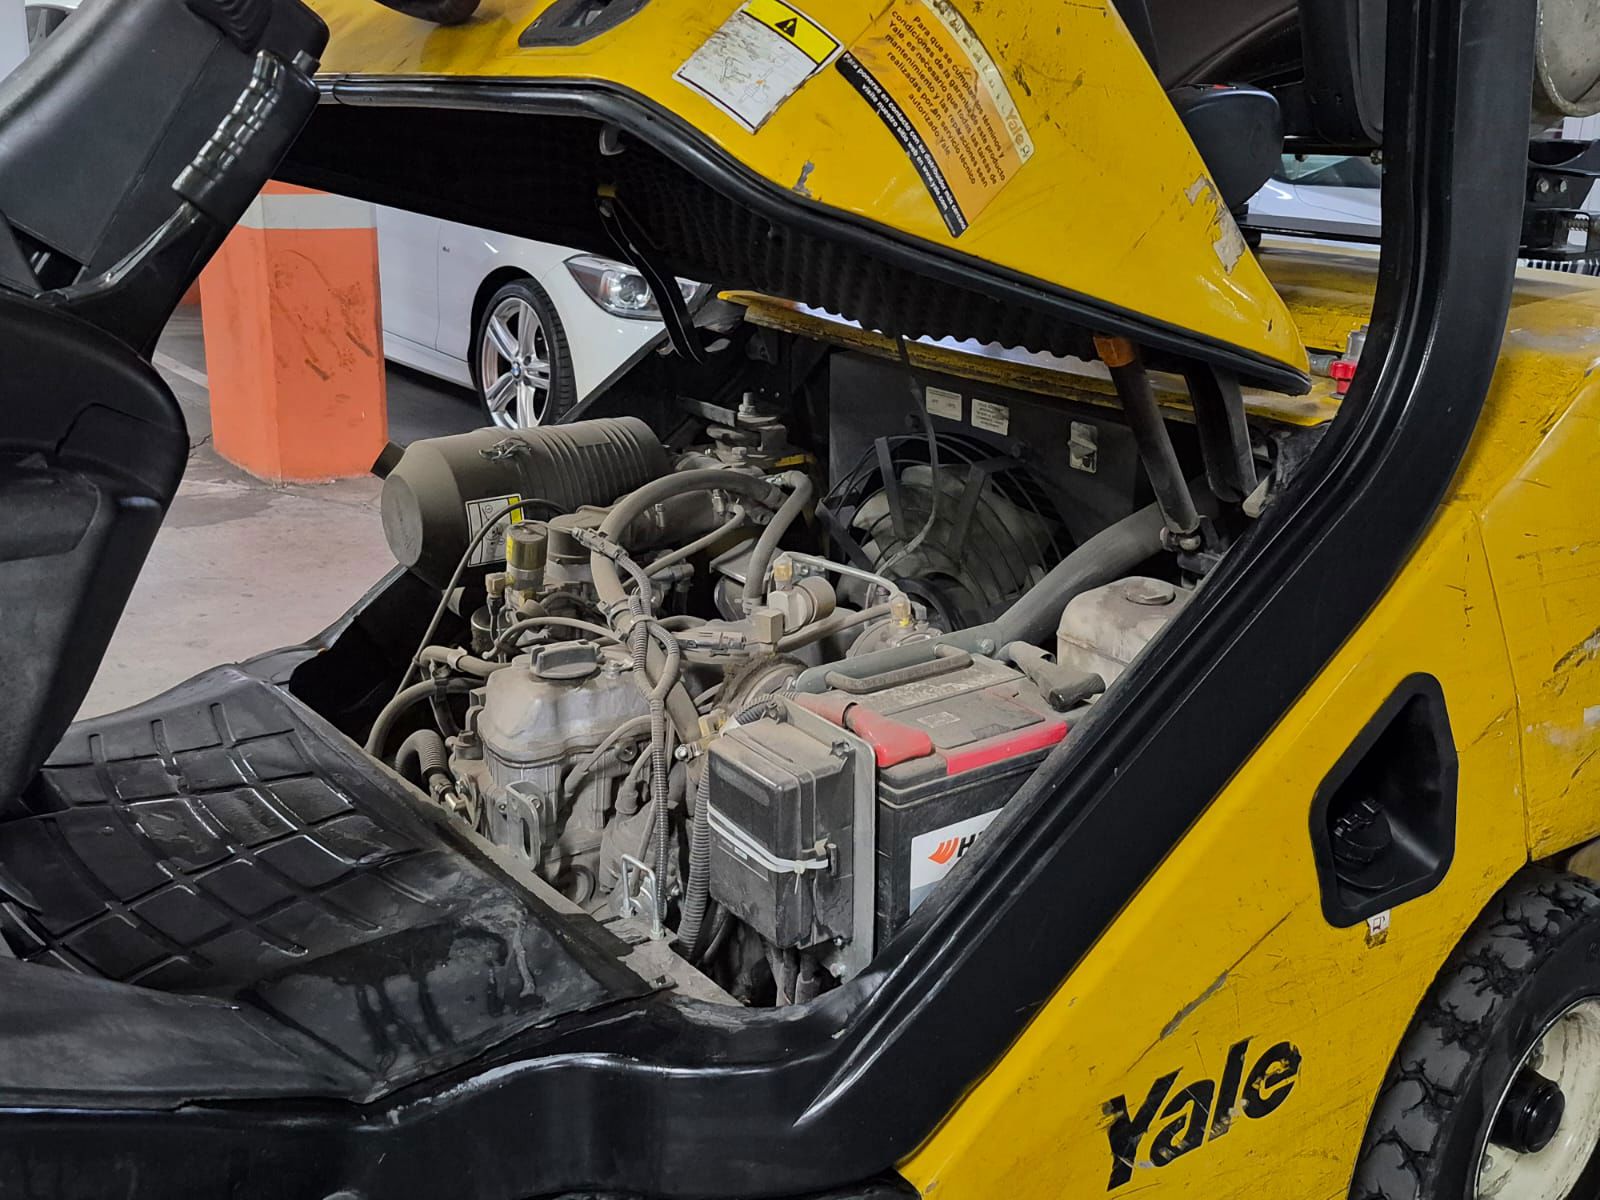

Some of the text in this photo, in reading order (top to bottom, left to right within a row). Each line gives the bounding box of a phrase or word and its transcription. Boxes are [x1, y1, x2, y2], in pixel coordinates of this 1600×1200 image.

[843, 53, 858, 69] Para
[856, 69, 881, 93] ponerse
[881, 93, 889, 103] en
[888, 102, 911, 131] contacto
[910, 131, 920, 144] con
[918, 144, 926, 154] su
[924, 153, 946, 190] distribuidor
[944, 190, 953, 204] más
[951, 204, 966, 230] cercano
[862, 84, 948, 210] visite nuestro sitio web en www.yale.com
[885, 34, 935, 93] mantenimiento
[939, 99, 948, 113] las
[976, 167, 988, 188] sean
[887, 51, 922, 92] realizadas
[920, 93, 934, 108] por
[941, 121, 961, 154] servicio
[960, 154, 976, 185] técnico
[891, 10, 935, 58] condiciones
[935, 58, 944, 70] de
[943, 69, 951, 79] la
[977, 126, 987, 144] este
[985, 145, 1006, 181] producto
[906, 41, 916, 52] es
[916, 52, 947, 91] necesario
[946, 92, 958, 109] que
[978, 147, 991, 173] tareas
[990, 173, 997, 185] de
[909, 93, 939, 137] autorizado
[913, 16, 930, 36] Para
[930, 36, 943, 52] que
[943, 53, 952, 64] se
[982, 114, 1001, 151] términos
[1006, 107, 1024, 145] Yale
[1101, 1036, 1302, 1192] Yale
